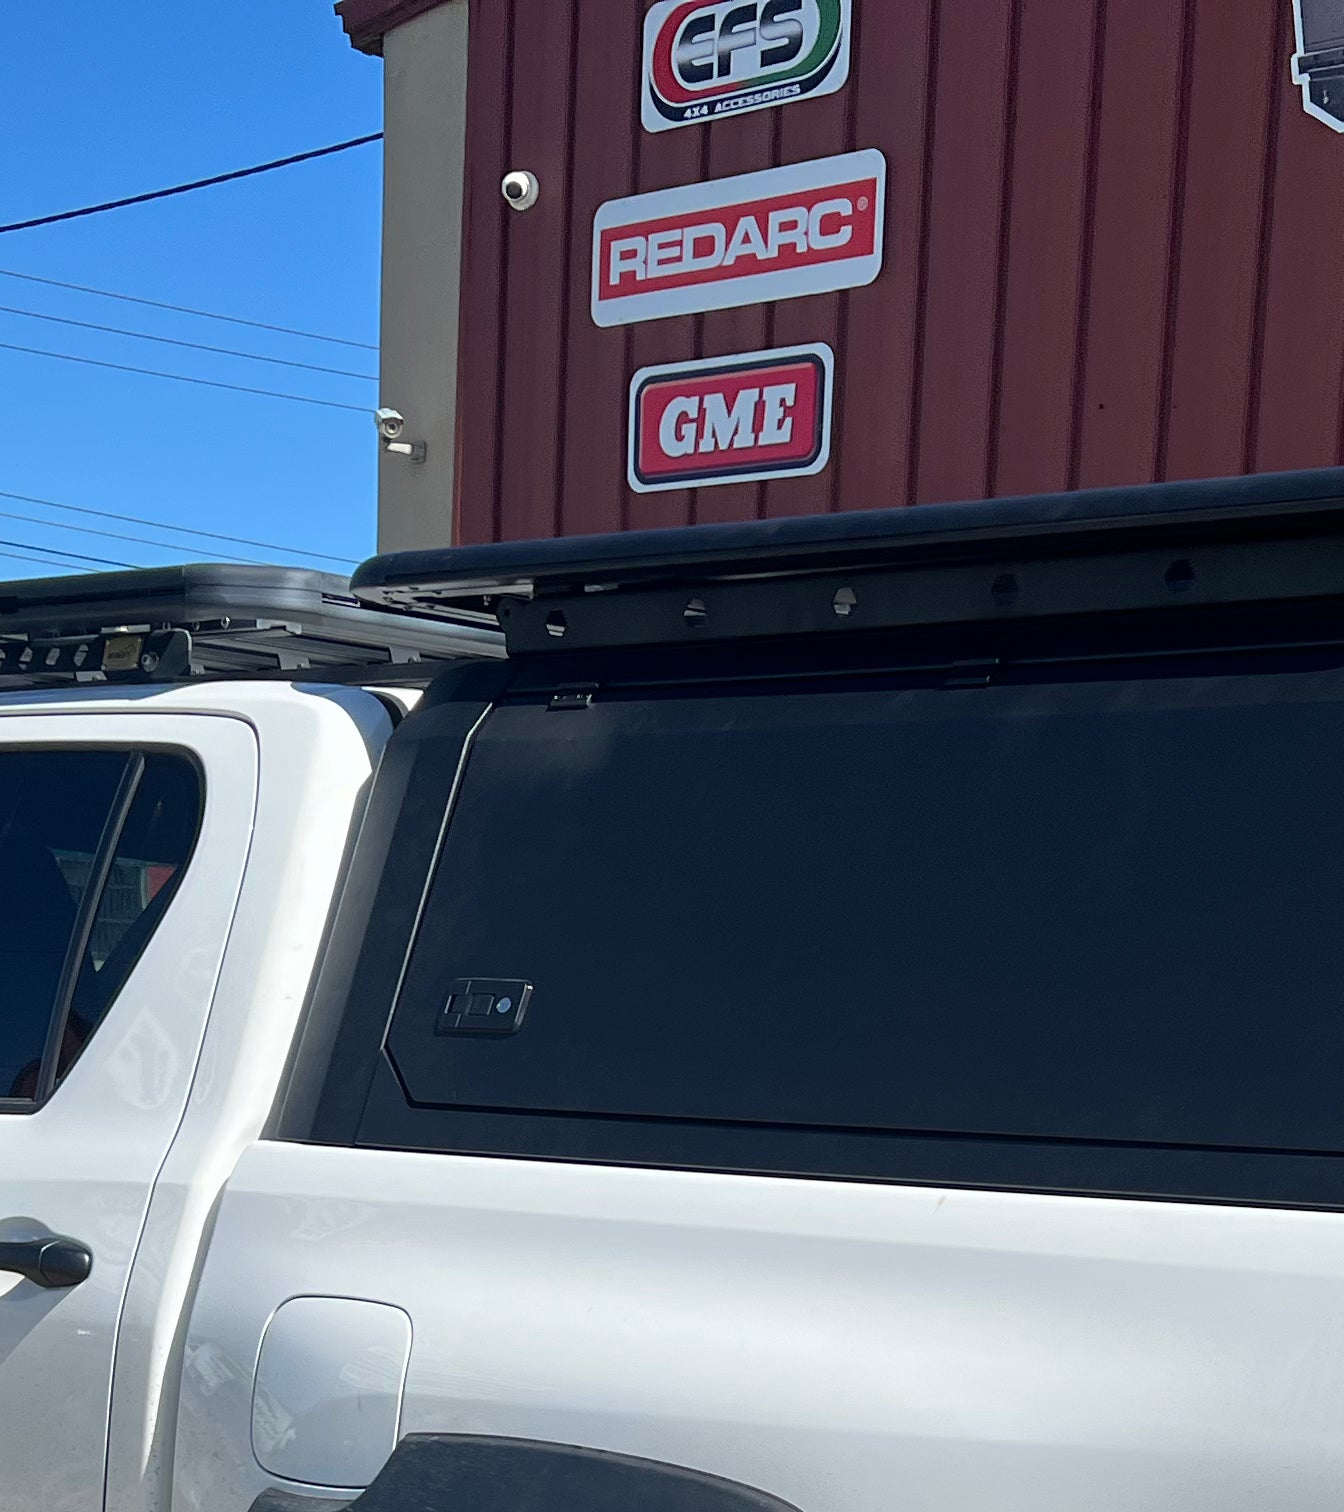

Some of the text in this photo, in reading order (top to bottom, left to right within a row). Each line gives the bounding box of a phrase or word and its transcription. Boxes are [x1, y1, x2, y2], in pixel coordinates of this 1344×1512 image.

[677, 0, 804, 83] EFS
[680, 83, 801, 119] 4X4 ACCESSORIES
[608, 197, 853, 286] REDARC
[658, 382, 796, 458] GME
